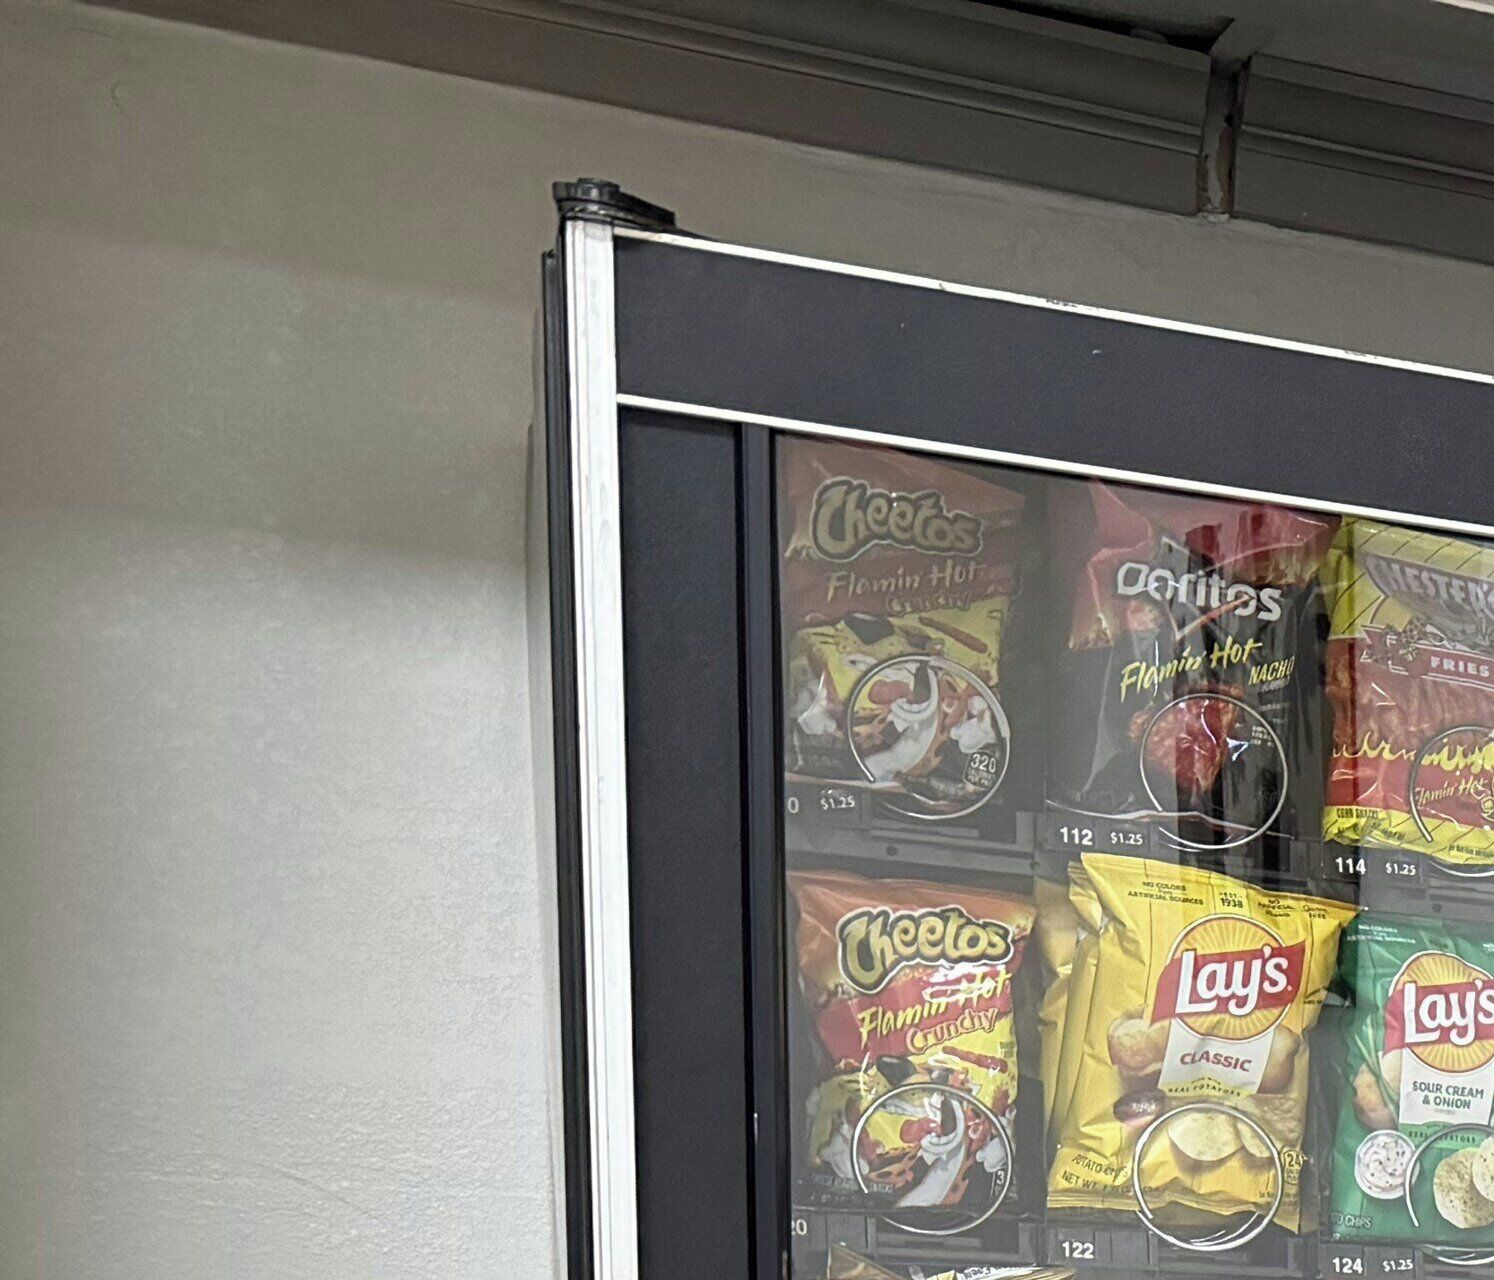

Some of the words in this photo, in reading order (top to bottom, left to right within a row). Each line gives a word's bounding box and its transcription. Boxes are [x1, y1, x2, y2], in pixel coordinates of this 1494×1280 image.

[814, 482, 982, 558] Cheetos
[1116, 561, 1283, 622] Doritos
[1209, 634, 1264, 669] Hot
[1429, 656, 1491, 678] FRIES
[969, 752, 998, 773] 320
[1060, 826, 1093, 845] 112
[1110, 831, 1144, 845] $1.25
[1335, 857, 1367, 875] 114
[1385, 863, 1417, 876] $1.25
[840, 907, 1010, 990] Cheetos
[1174, 944, 1290, 1017] Lay's
[906, 1007, 999, 1053] Crunchy
[1178, 1049, 1253, 1073] CLASSIC
[1412, 1080, 1443, 1096] SOUR
[1445, 1085, 1484, 1099] CREAM
[1432, 1096, 1472, 1110] ONION
[1061, 1240, 1095, 1258] 122
[1332, 1257, 1363, 1274] 124
[1382, 1258, 1414, 1272] $1.25
